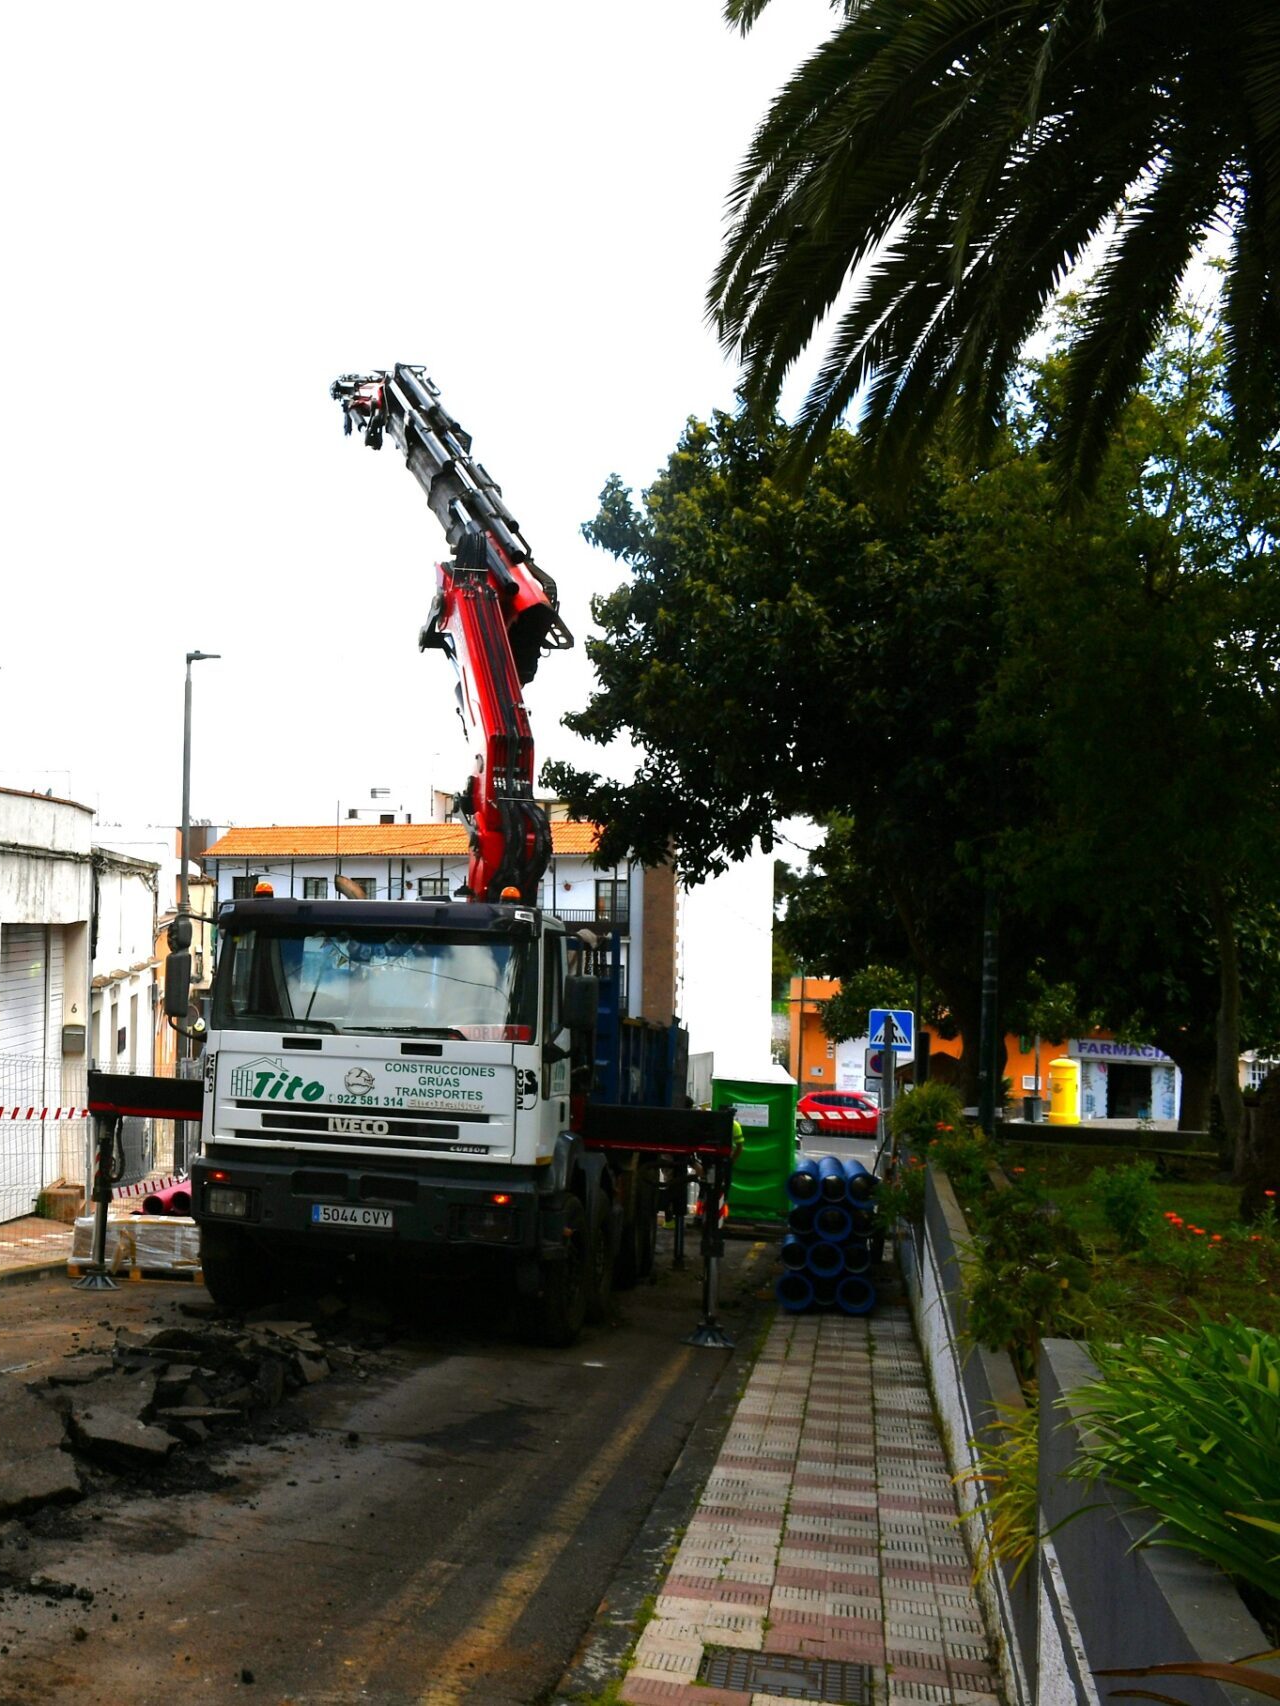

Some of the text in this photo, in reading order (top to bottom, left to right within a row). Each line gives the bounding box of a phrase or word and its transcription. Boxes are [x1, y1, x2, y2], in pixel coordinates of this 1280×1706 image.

[71, 1003, 77, 1013] 6
[385, 1063, 495, 1077] CONSTRUCCIONES
[252, 1072, 324, 1101] Tito
[337, 1094, 403, 1106] 922 581 314
[395, 1087, 483, 1101] TRANSPORTES
[328, 1117, 389, 1135] IVECO
[323, 1208, 389, 1225] 5044 CVY
